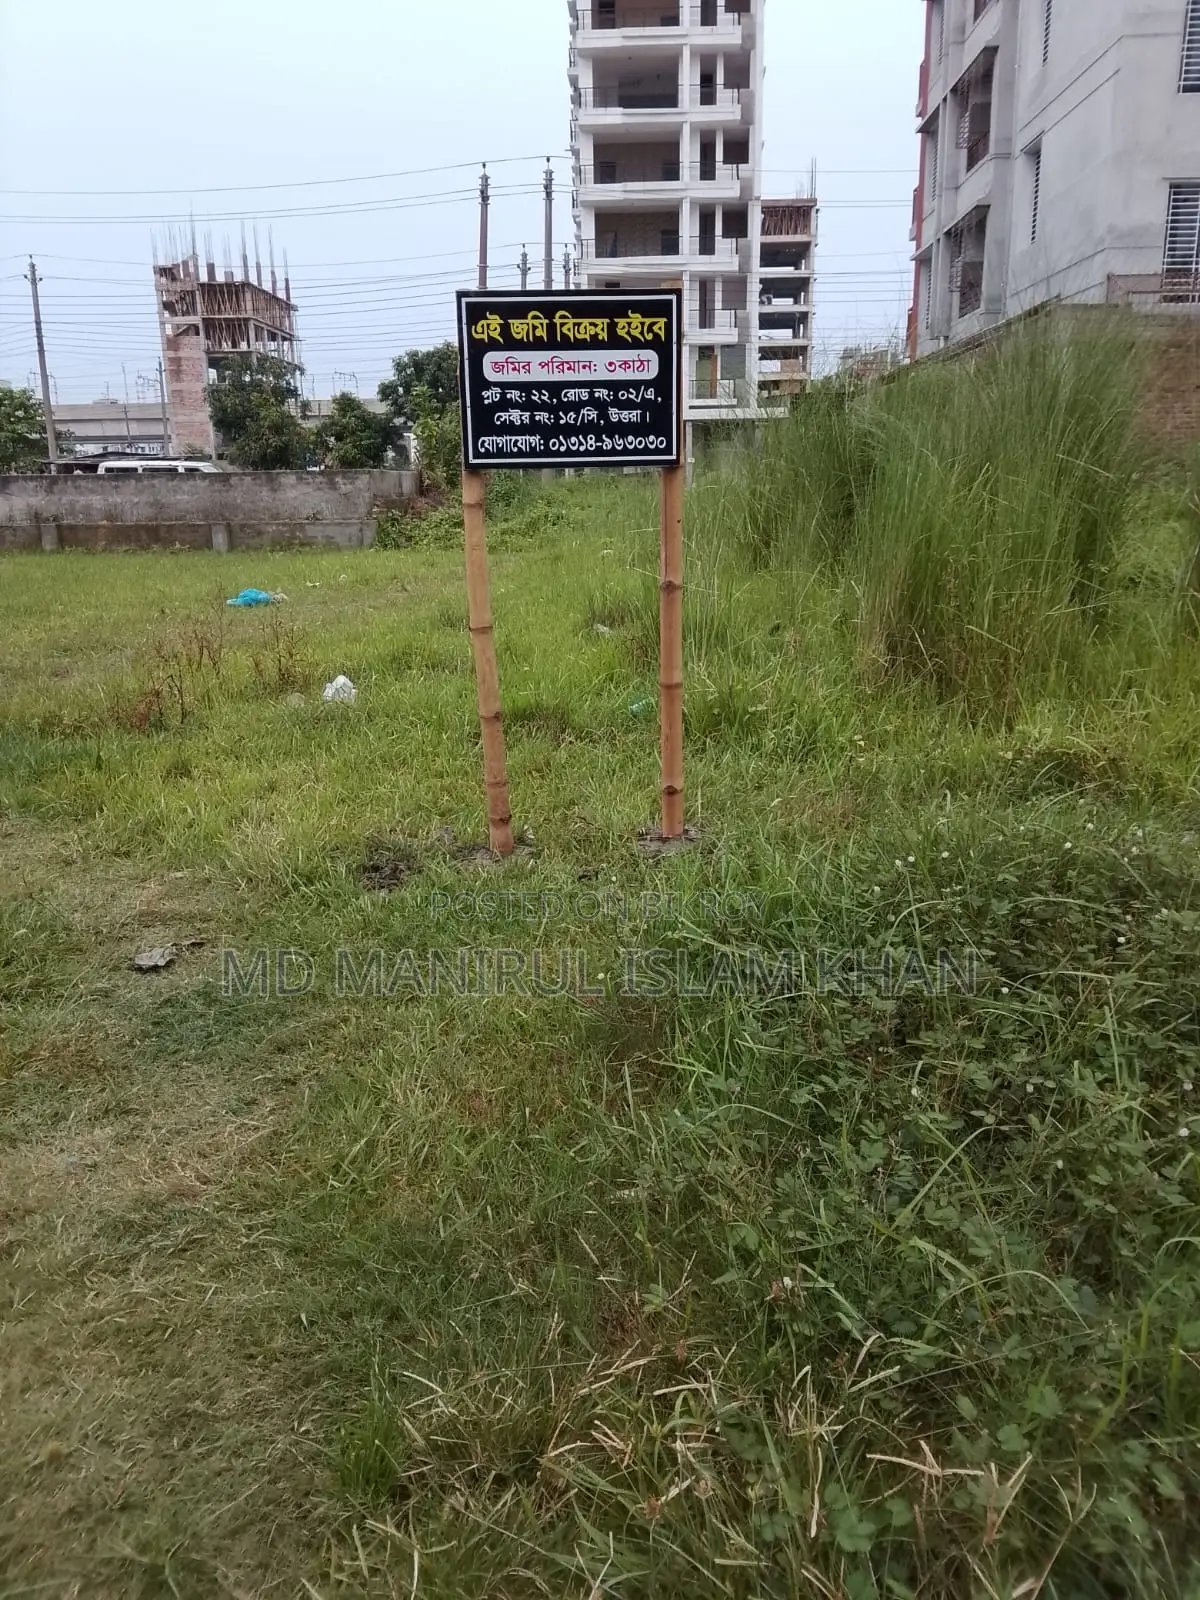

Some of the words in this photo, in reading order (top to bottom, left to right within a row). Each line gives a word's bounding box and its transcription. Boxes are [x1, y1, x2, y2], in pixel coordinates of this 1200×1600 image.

[471, 311, 504, 344] এই
[508, 310, 549, 343] জমি
[553, 310, 610, 343] বিক্রয়
[614, 310, 668, 343] হইবে
[490, 356, 531, 375] জমির
[538, 355, 598, 375] পরিমান:
[604, 354, 652, 374] ৩কাঠা
[481, 387, 501, 404] প্লট
[505, 389, 526, 403] নং:
[561, 388, 591, 402] রোড
[594, 388, 614, 402] নং:
[494, 409, 530, 425] সেক্টর
[534, 412, 554, 425] নং:
[478, 434, 545, 454] যোগাযোগ:
[549, 434, 667, 451] ০১৩১৪-৯৬৩০৩০
